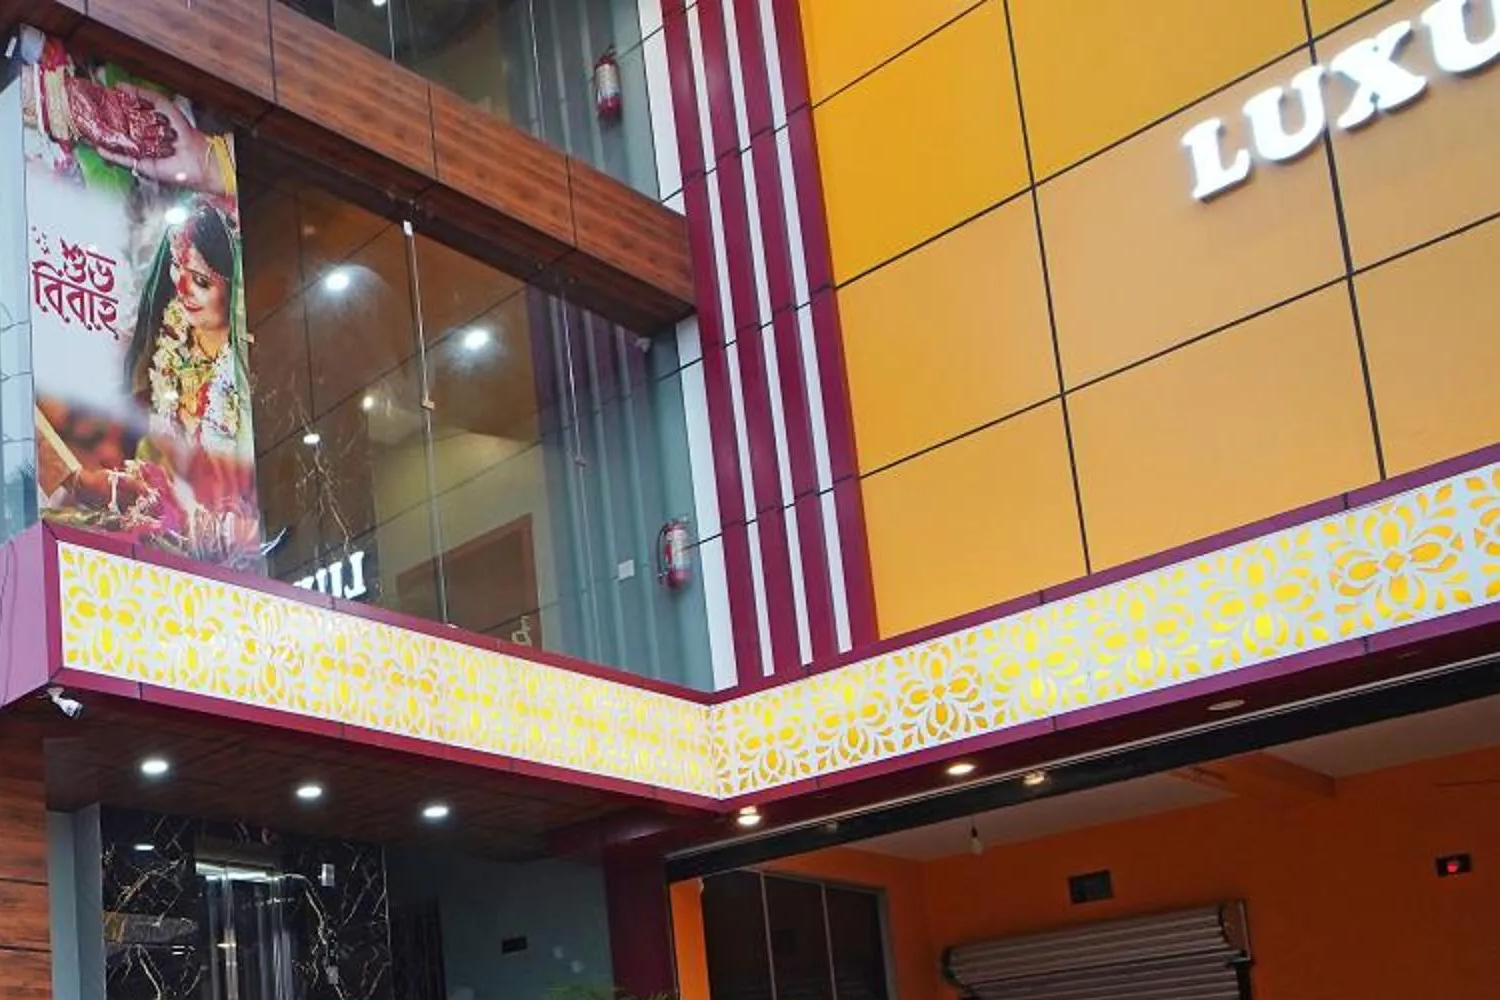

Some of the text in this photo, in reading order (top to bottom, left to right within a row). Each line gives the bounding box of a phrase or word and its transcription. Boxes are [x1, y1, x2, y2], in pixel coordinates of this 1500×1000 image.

[1180, 0, 1500, 200] LUXU
[31, 260, 119, 340] বিবাহ
[60, 238, 116, 293] শুভ
